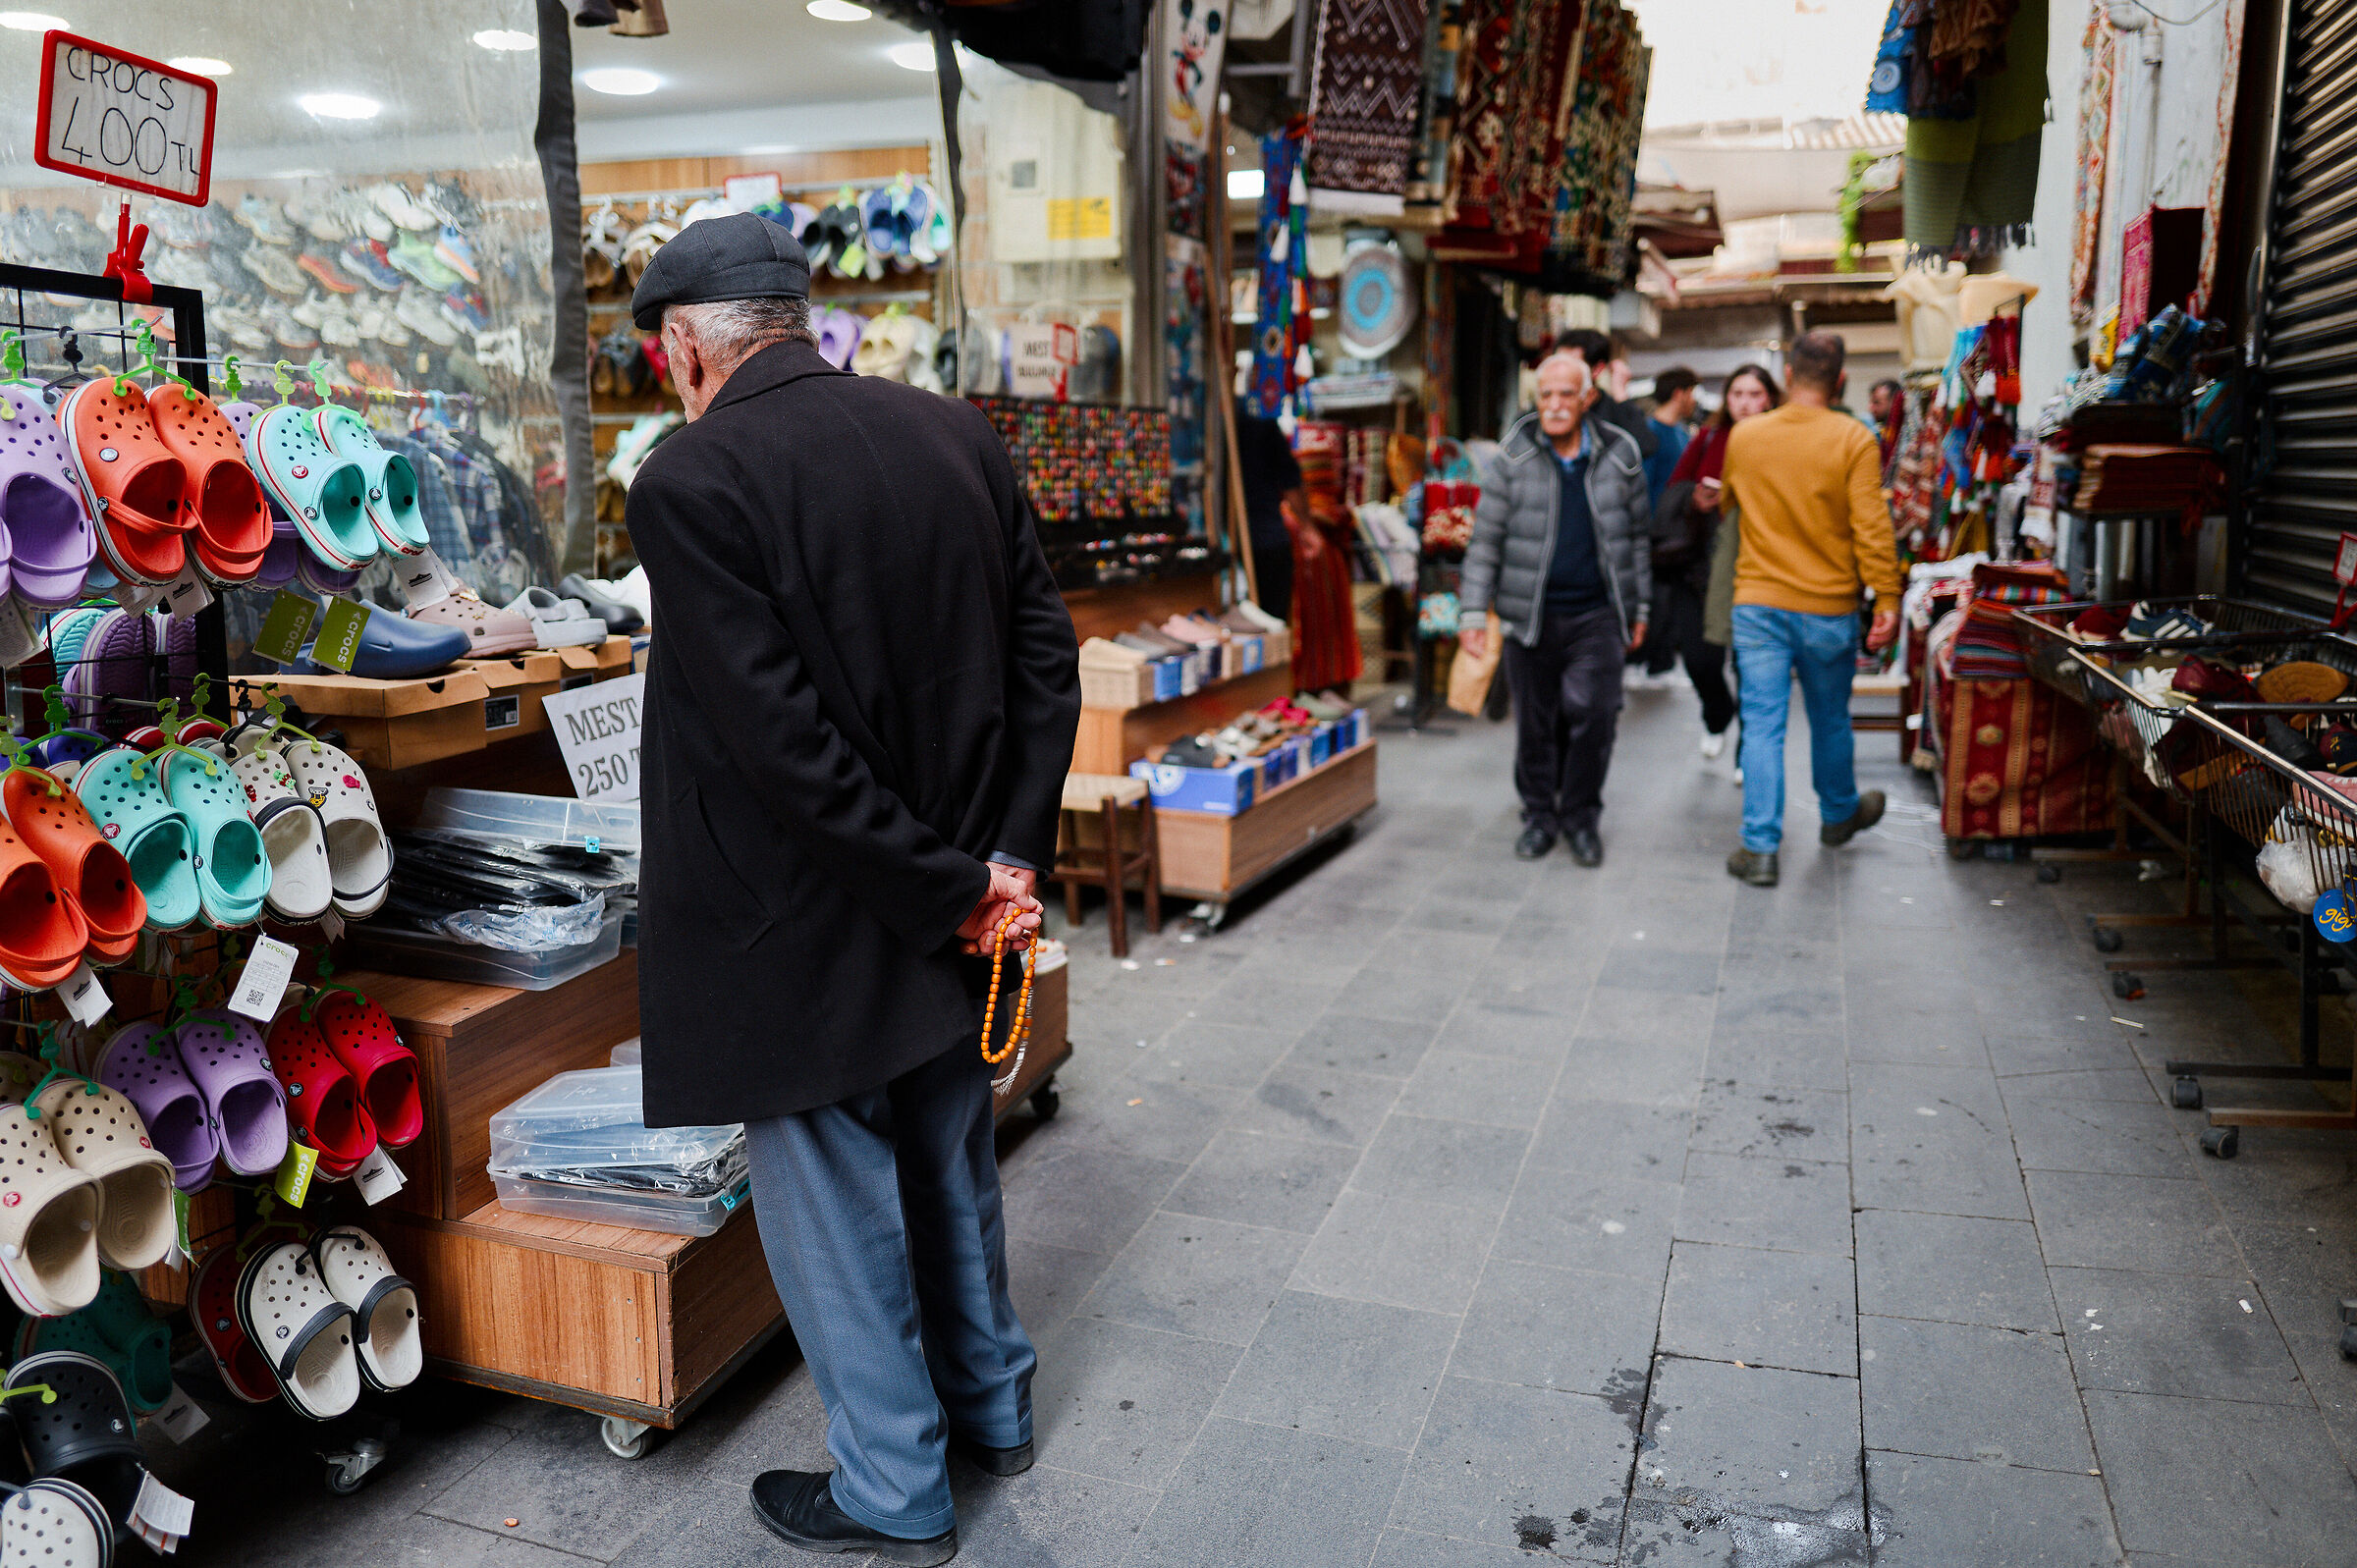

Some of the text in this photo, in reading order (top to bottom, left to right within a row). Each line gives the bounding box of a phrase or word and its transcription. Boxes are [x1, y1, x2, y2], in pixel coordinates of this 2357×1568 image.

[68, 46, 174, 110] CROCS
[282, 616, 306, 657] crocs
[337, 621, 359, 665] crocs
[564, 696, 641, 746] MEST
[577, 753, 629, 797] 250
[289, 1162, 310, 1203] crocs
